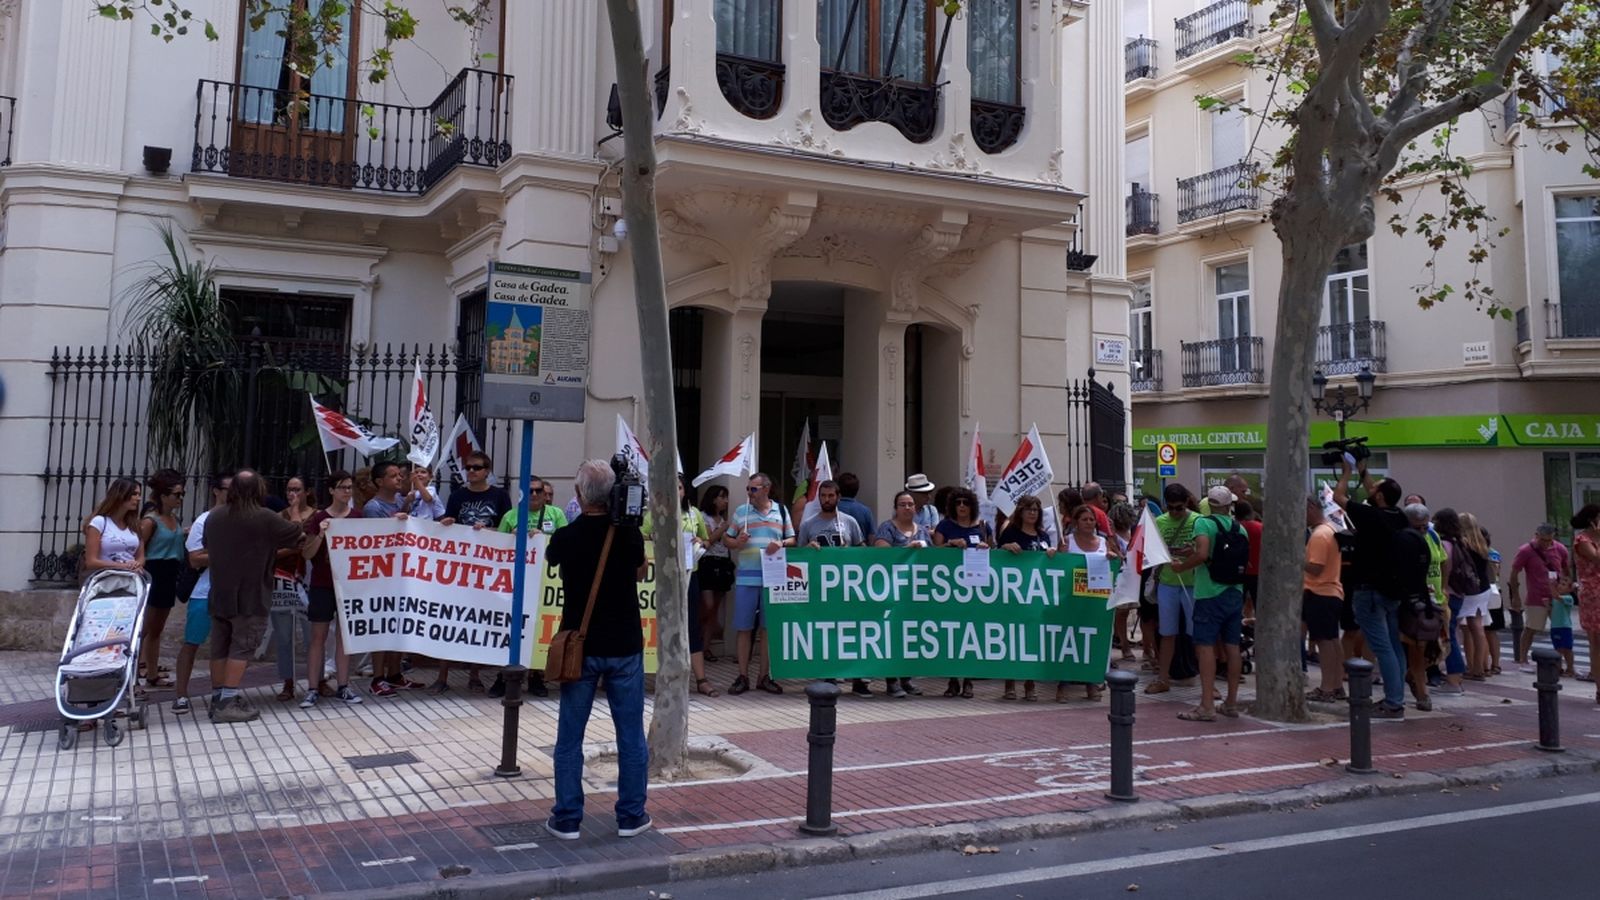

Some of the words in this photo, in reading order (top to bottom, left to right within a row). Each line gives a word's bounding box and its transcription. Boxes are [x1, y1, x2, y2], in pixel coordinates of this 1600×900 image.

[494, 280, 517, 290] Casa
[518, 282, 529, 291] de
[530, 281, 569, 295] Gadea.
[494, 292, 516, 301] Casa
[518, 294, 529, 302] de
[530, 293, 569, 307] Gadea.
[1168, 433, 1206, 445] RURAL
[1207, 431, 1262, 444] CENTRAL
[1525, 422, 1585, 439] CAJA
[331, 532, 471, 556] PROFESSORAT
[347, 553, 395, 580] EN
[401, 552, 514, 594] LLUITA
[820, 563, 1065, 606] PROFESSORAT
[343, 598, 364, 614] ER
[369, 596, 395, 613] UN
[399, 596, 530, 629] ENSENYAMENT
[347, 616, 396, 636] BLIC
[402, 618, 425, 637] DE
[429, 624, 525, 649] QUALITA
[782, 610, 892, 660] INTERÍ
[902, 619, 1098, 665] ESTABILITAT
